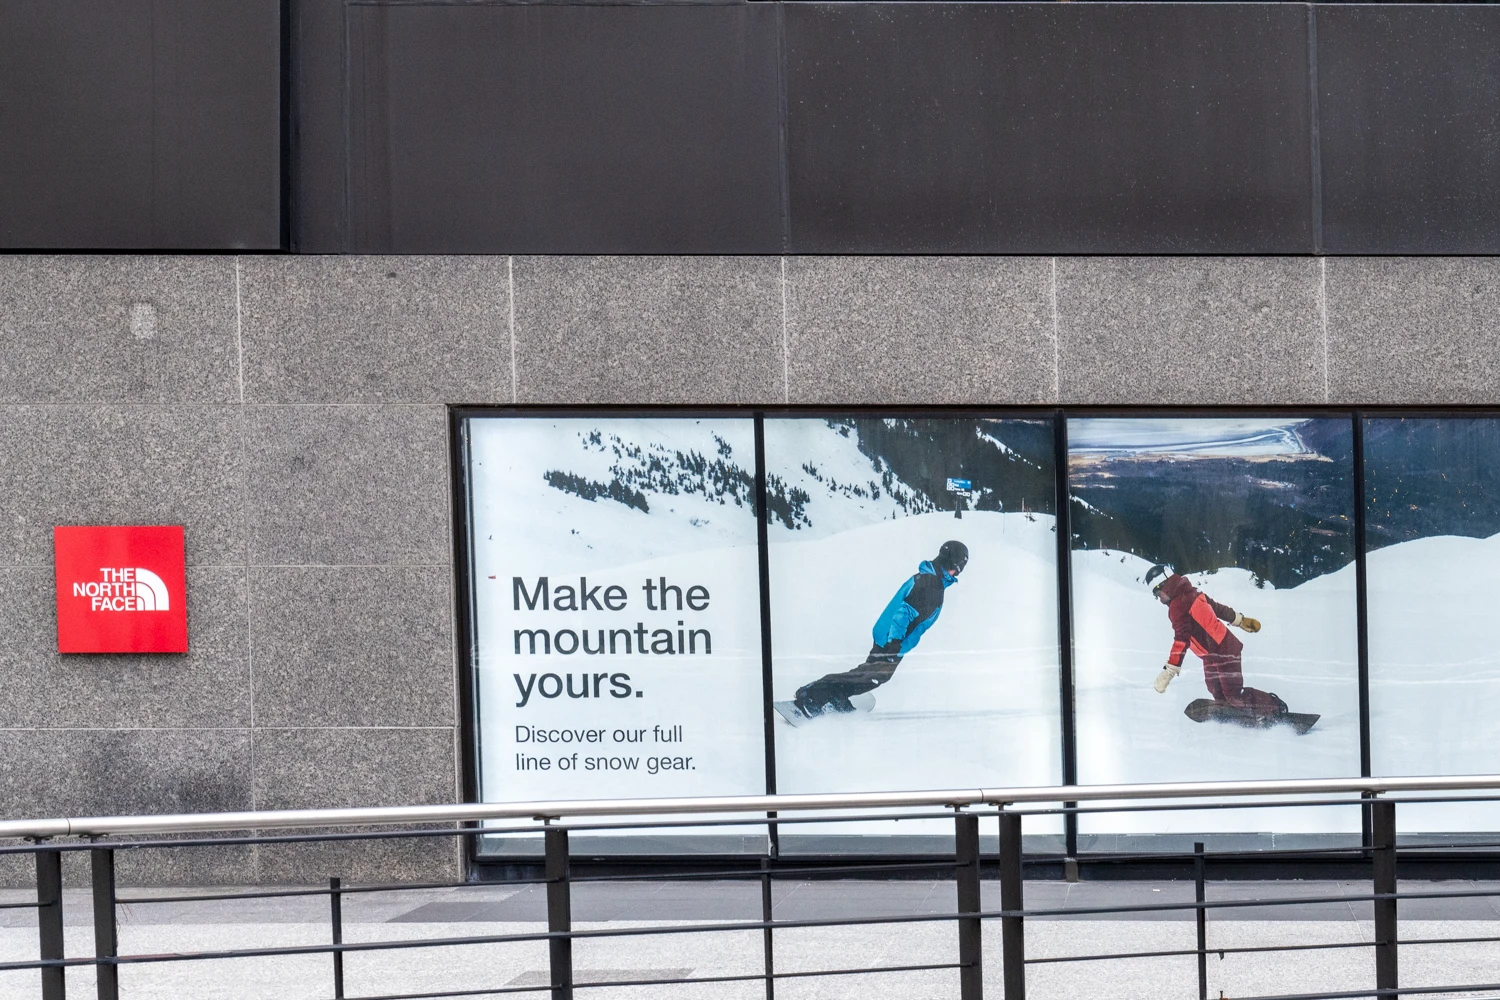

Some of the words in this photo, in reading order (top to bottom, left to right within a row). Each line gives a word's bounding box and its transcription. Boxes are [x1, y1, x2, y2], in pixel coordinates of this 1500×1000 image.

[100, 568, 134, 582] THE
[73, 582, 135, 597] NORTH
[513, 576, 628, 611] Make
[643, 576, 710, 611] the
[91, 596, 136, 612] FACE
[514, 620, 712, 655] mountain
[514, 673, 643, 707] yours.
[515, 725, 606, 743] Discover
[612, 730, 647, 743] our
[653, 725, 683, 743] full
[516, 753, 551, 771] line
[558, 753, 578, 771] of
[584, 757, 640, 771] snow
[647, 757, 696, 775] gear.
